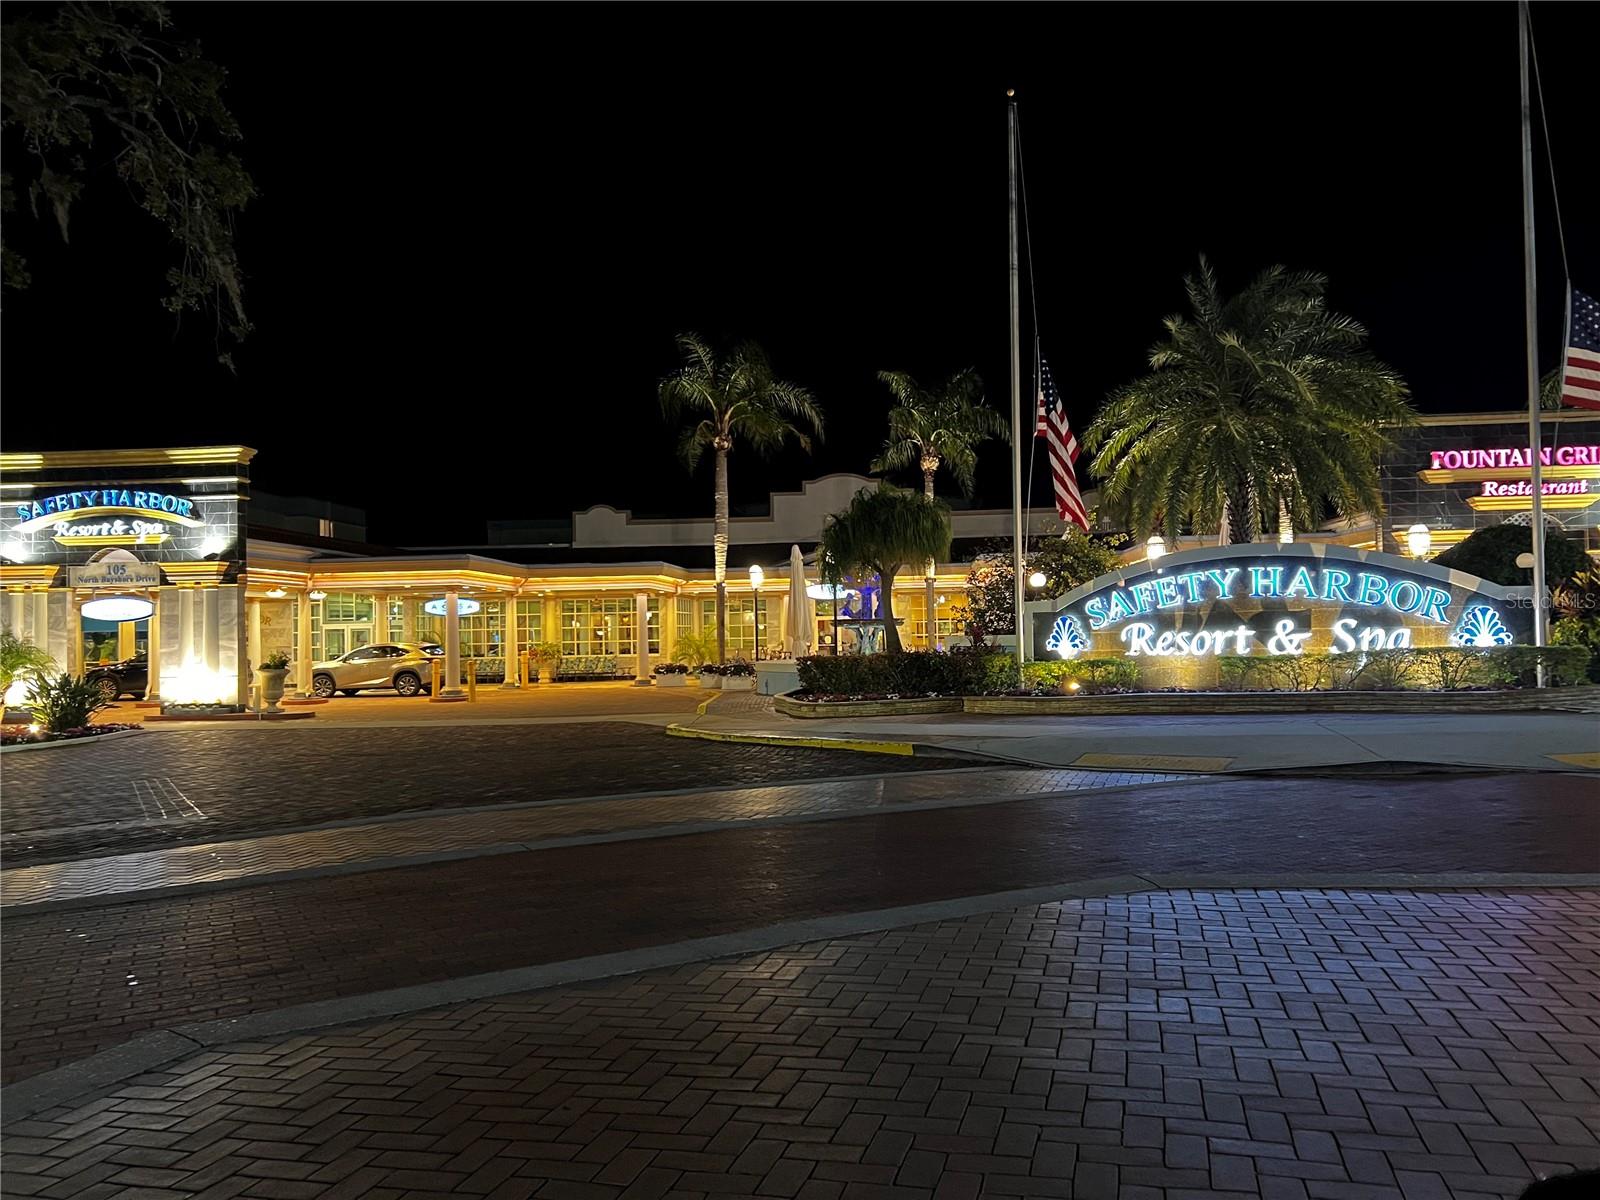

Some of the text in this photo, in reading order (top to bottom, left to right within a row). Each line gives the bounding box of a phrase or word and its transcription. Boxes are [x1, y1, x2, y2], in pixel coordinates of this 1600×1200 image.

[1430, 446, 1600, 469] FOUNTAIN GRI
[16, 489, 194, 522] SAFETY HARBOR
[53, 520, 164, 543] Resort & Spa
[78, 576, 99, 584] North
[135, 574, 156, 583] Drive
[106, 564, 128, 576] 105
[1085, 566, 1452, 631] SAFETY HARBOR
[1121, 619, 1414, 672] Resort & Spa
